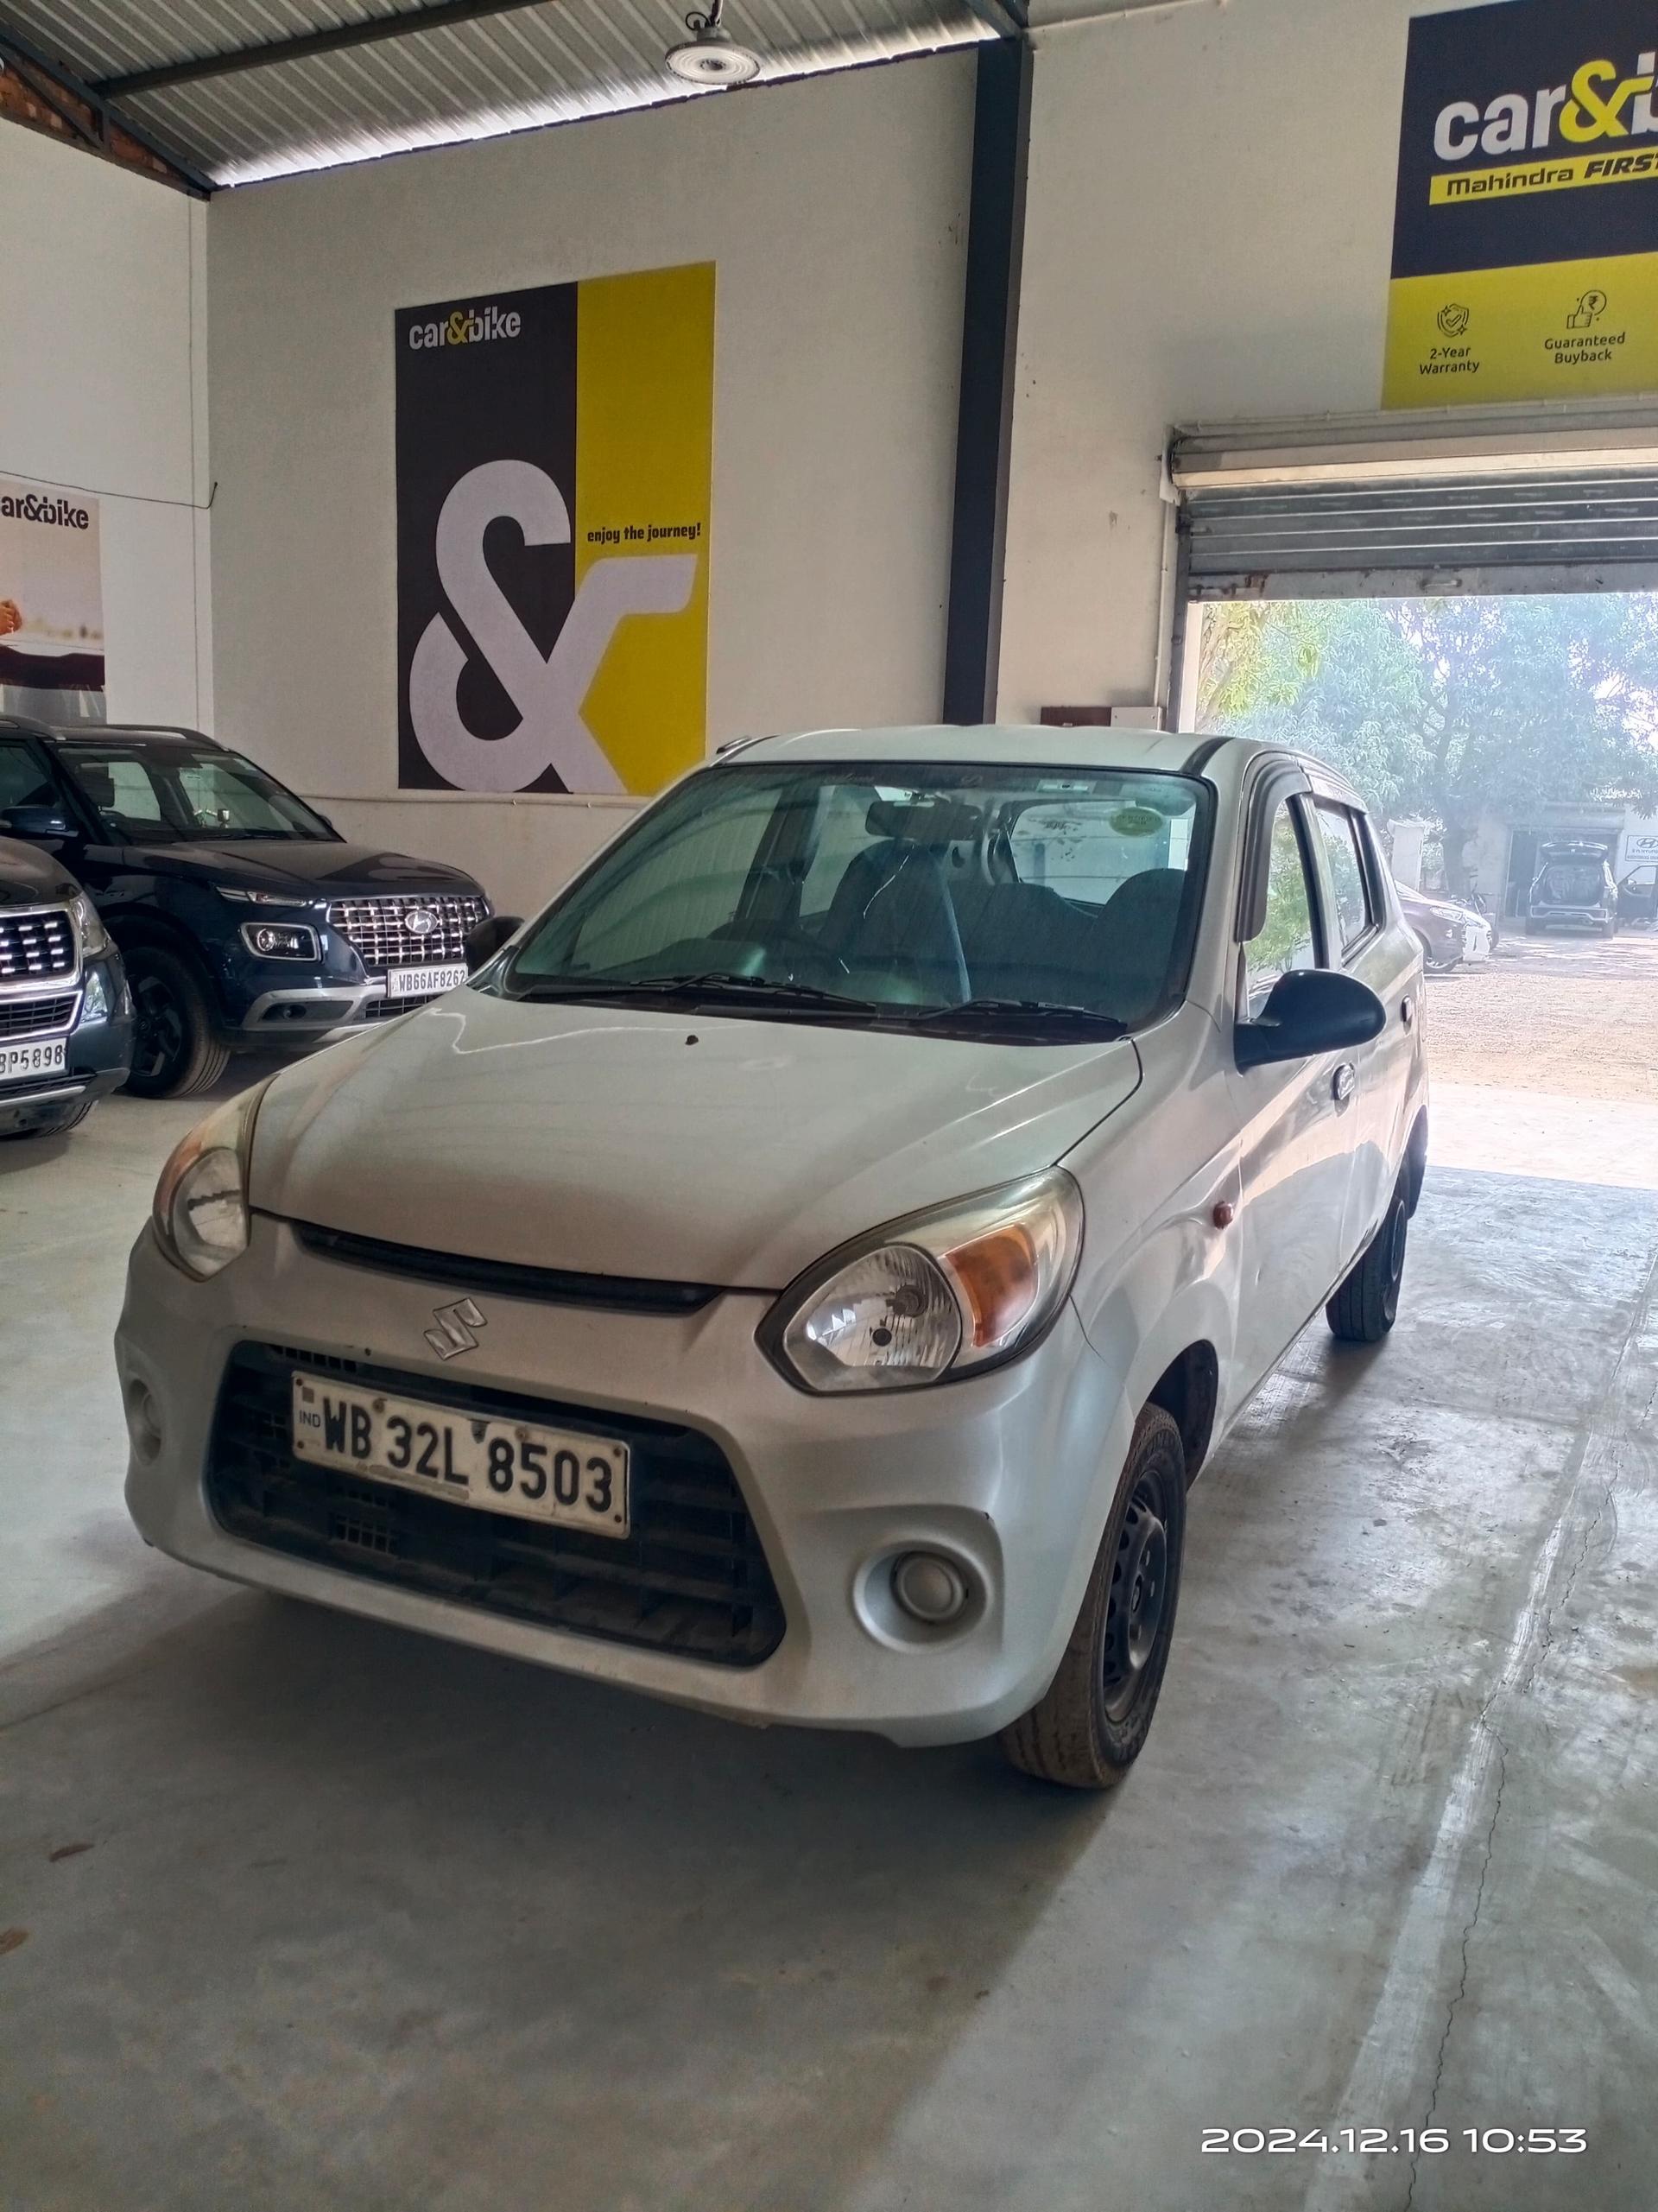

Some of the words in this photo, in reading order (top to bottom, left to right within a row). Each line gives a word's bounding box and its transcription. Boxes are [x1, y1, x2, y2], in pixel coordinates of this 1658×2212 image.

[1446, 168, 1573, 196] Mahindra
[1584, 152, 1658, 179] FIRS
[408, 306, 522, 350] car&bike
[1544, 332, 1625, 351] Guaranteed
[1429, 346, 1471, 360] 2-Year
[1554, 349, 1612, 364] Buyback
[1419, 360, 1480, 375] Warranty
[587, 526, 621, 545] enjoy
[623, 525, 644, 540] the
[646, 522, 701, 542] journey!
[399, 969, 465, 992] WB66AF8262
[299, 1409, 321, 1429] IND
[323, 1396, 372, 1460] WB
[386, 1415, 469, 1486] 32L
[487, 1436, 613, 1513] 8503
